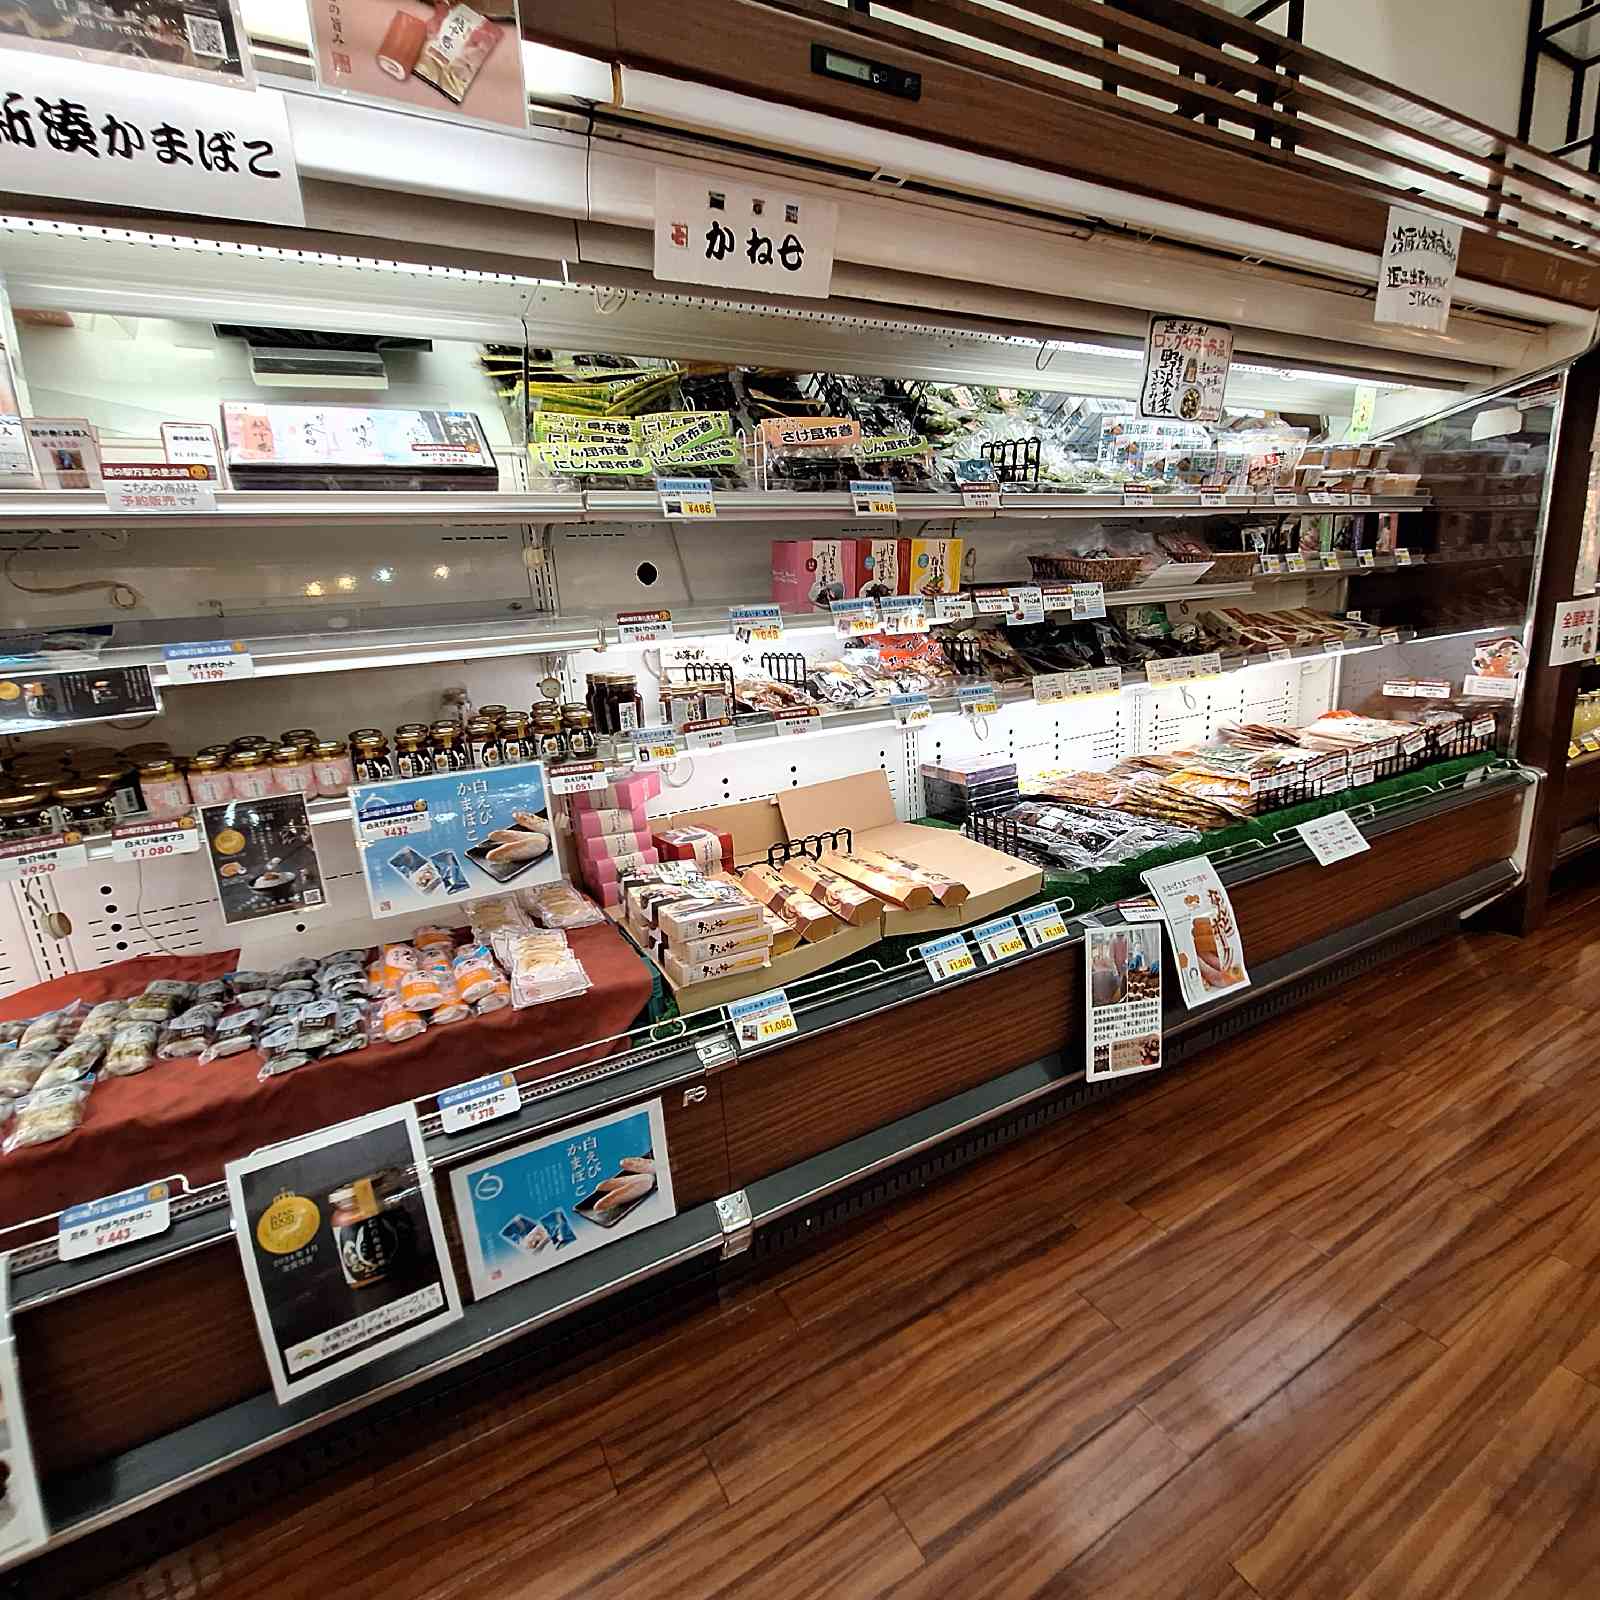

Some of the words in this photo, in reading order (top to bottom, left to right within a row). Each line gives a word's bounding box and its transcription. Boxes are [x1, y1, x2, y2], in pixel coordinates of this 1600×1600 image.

[781, 424, 853, 443] さけ昆布巻
[553, 458, 645, 469] にしん昆布巻
[653, 449, 734, 466] にしん昆布巻
[688, 503, 712, 514] ¥486
[457, 782, 479, 841] かまぼこ
[473, 779, 496, 825] 白えび
[21, 863, 56, 875] ¥950
[582, 1135, 602, 1178] 白えび
[566, 1143, 587, 1197] かまぼこ
